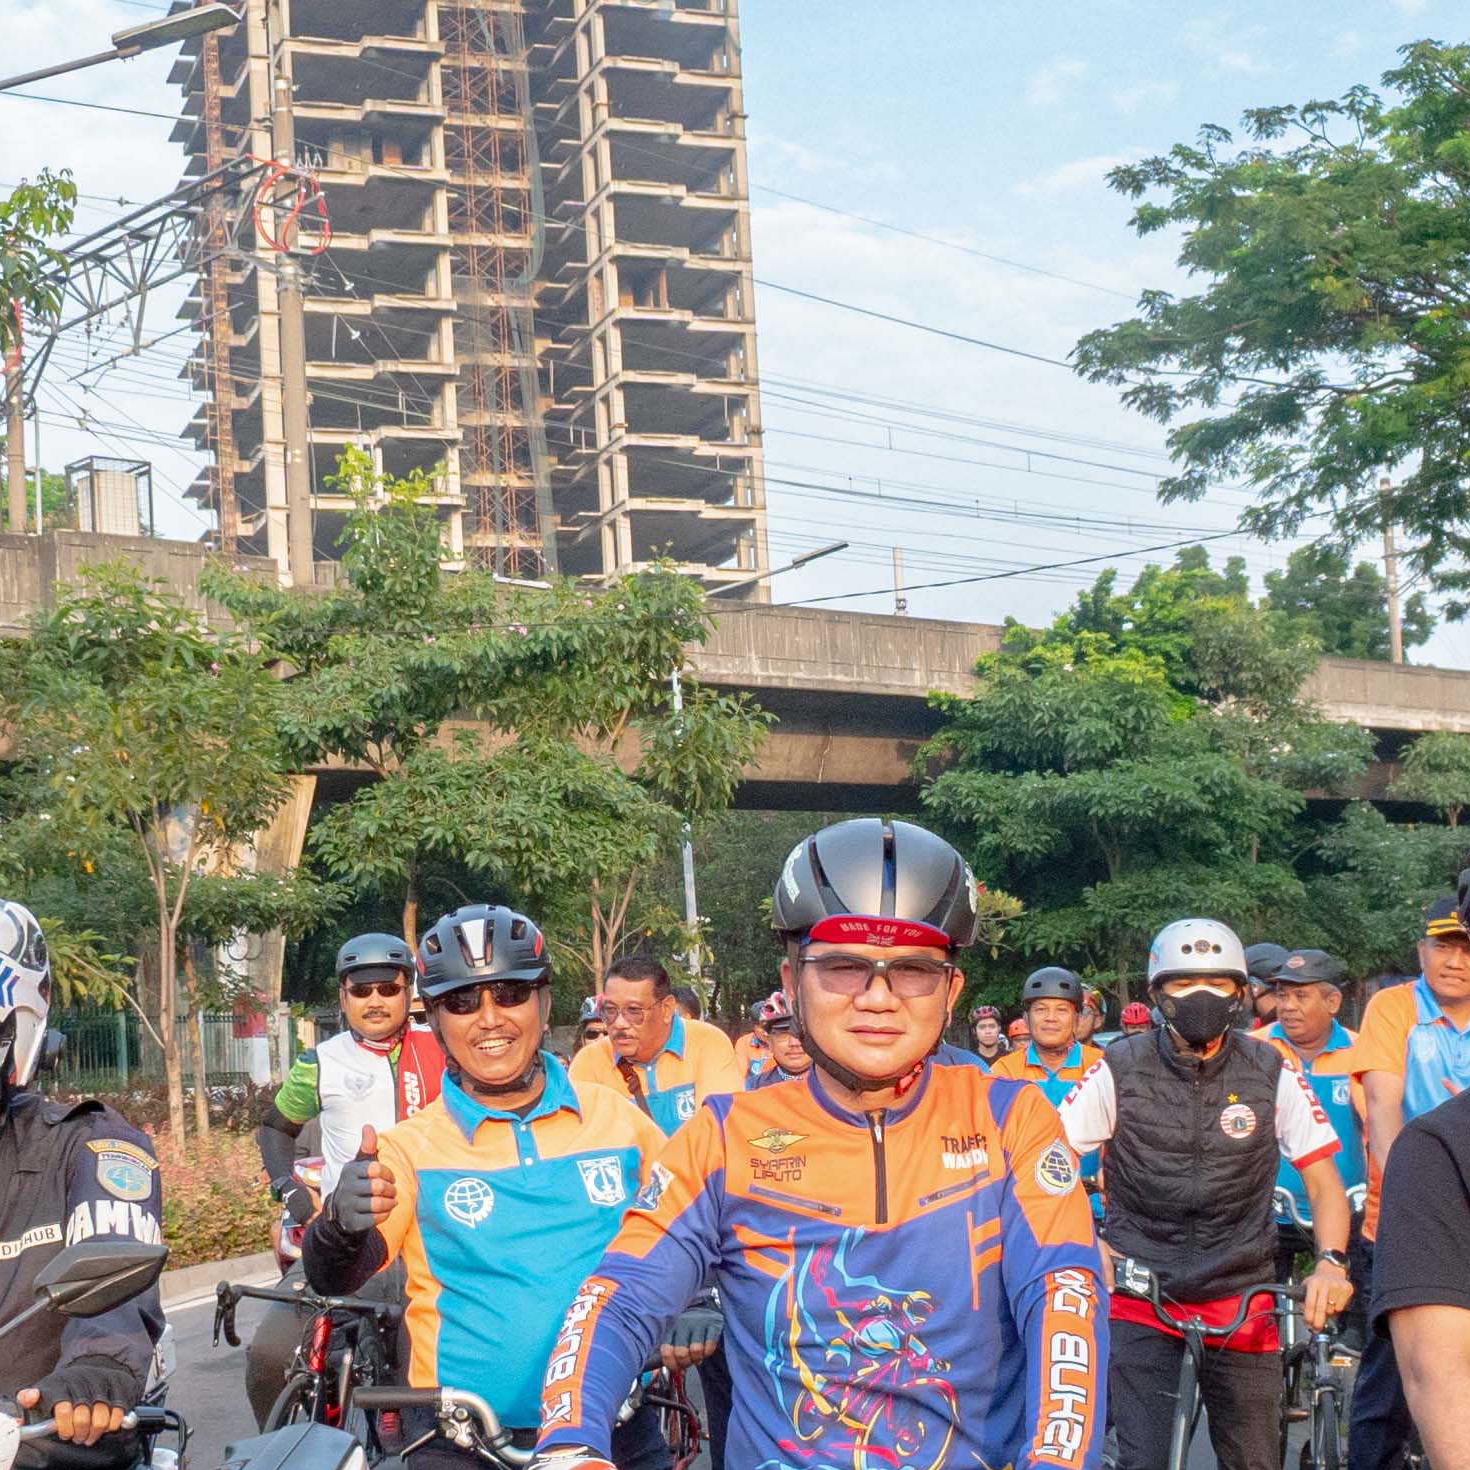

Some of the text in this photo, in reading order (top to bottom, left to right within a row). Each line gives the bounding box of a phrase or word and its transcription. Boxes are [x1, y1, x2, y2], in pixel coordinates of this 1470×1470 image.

[839, 923, 923, 938] MADE FOR YOU
[750, 1155, 806, 1170] SYAFRIN
[753, 1169, 802, 1182] LIPUTO
